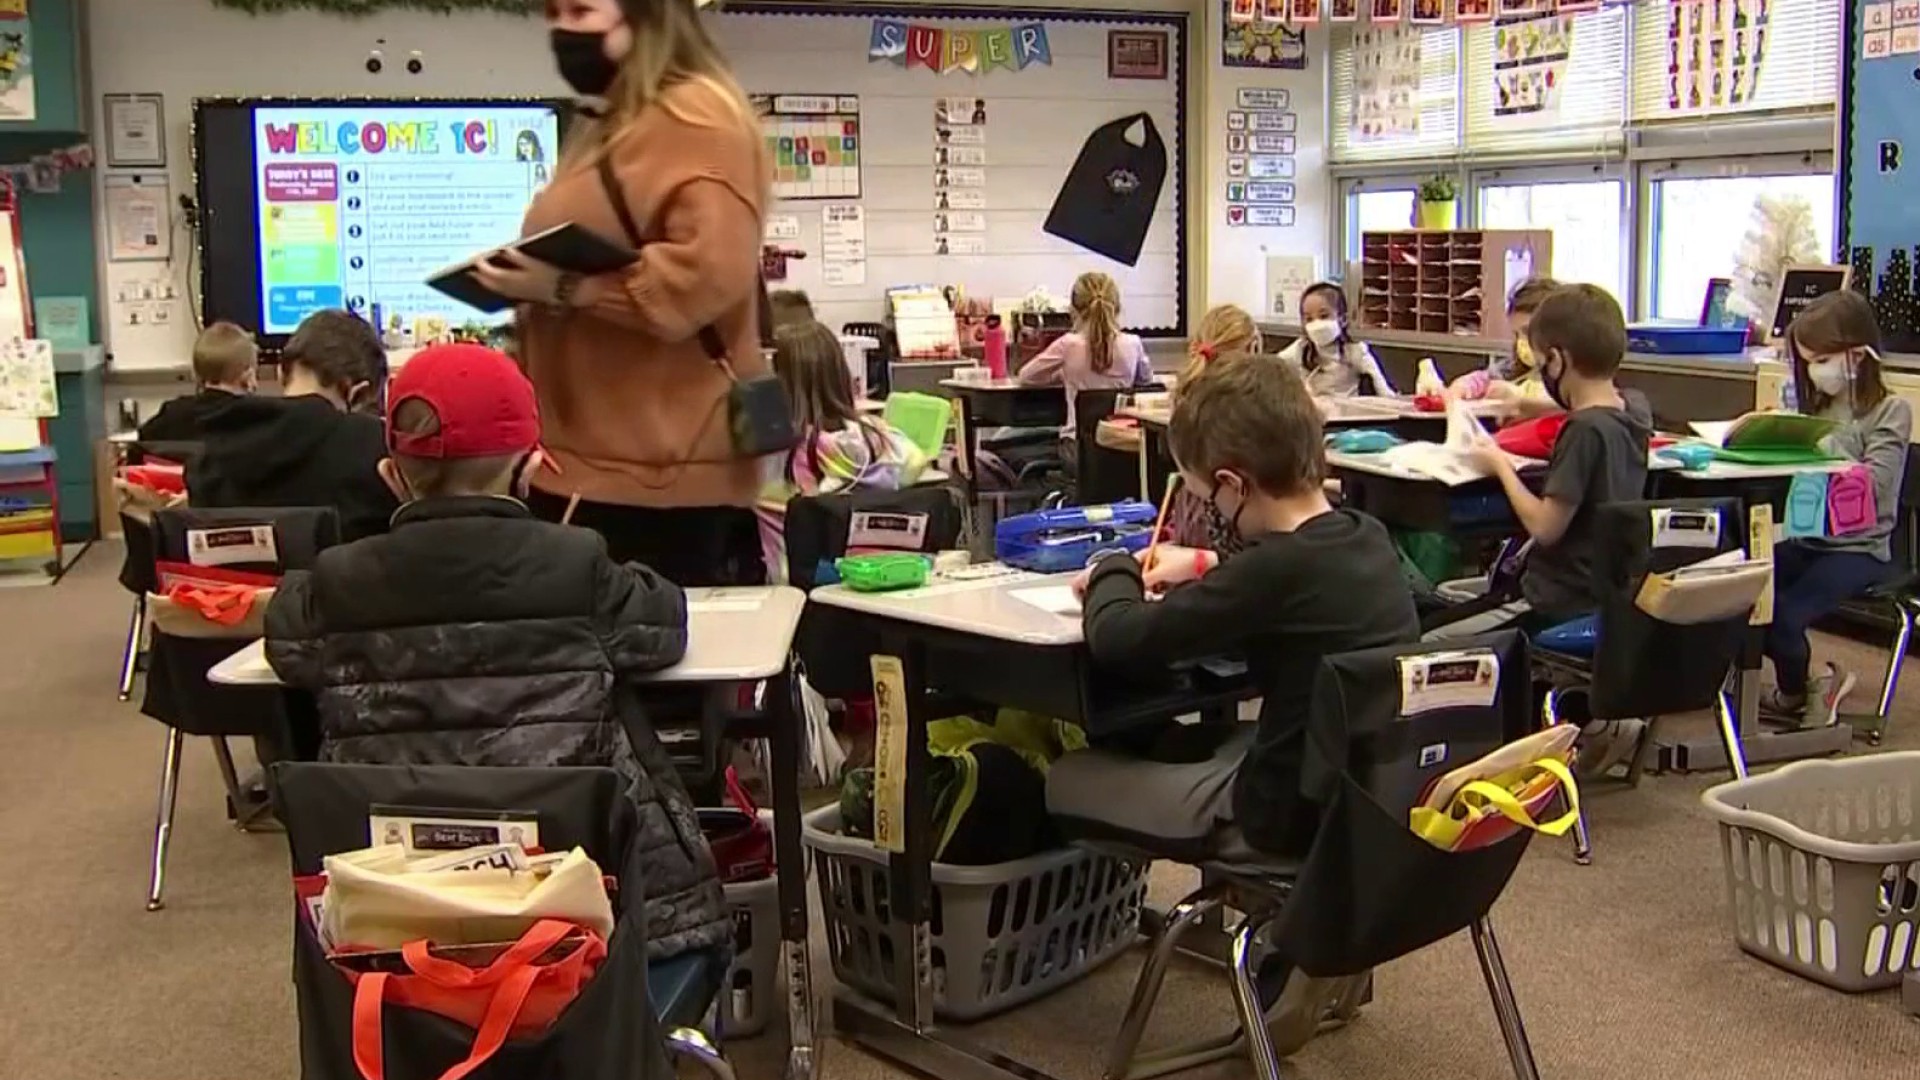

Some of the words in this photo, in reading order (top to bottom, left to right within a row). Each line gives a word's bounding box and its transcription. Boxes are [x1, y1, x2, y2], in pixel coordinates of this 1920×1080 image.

[881, 25, 1040, 61] SUPER
[265, 121, 438, 154] WELCOME
[1879, 140, 1902, 174] R
